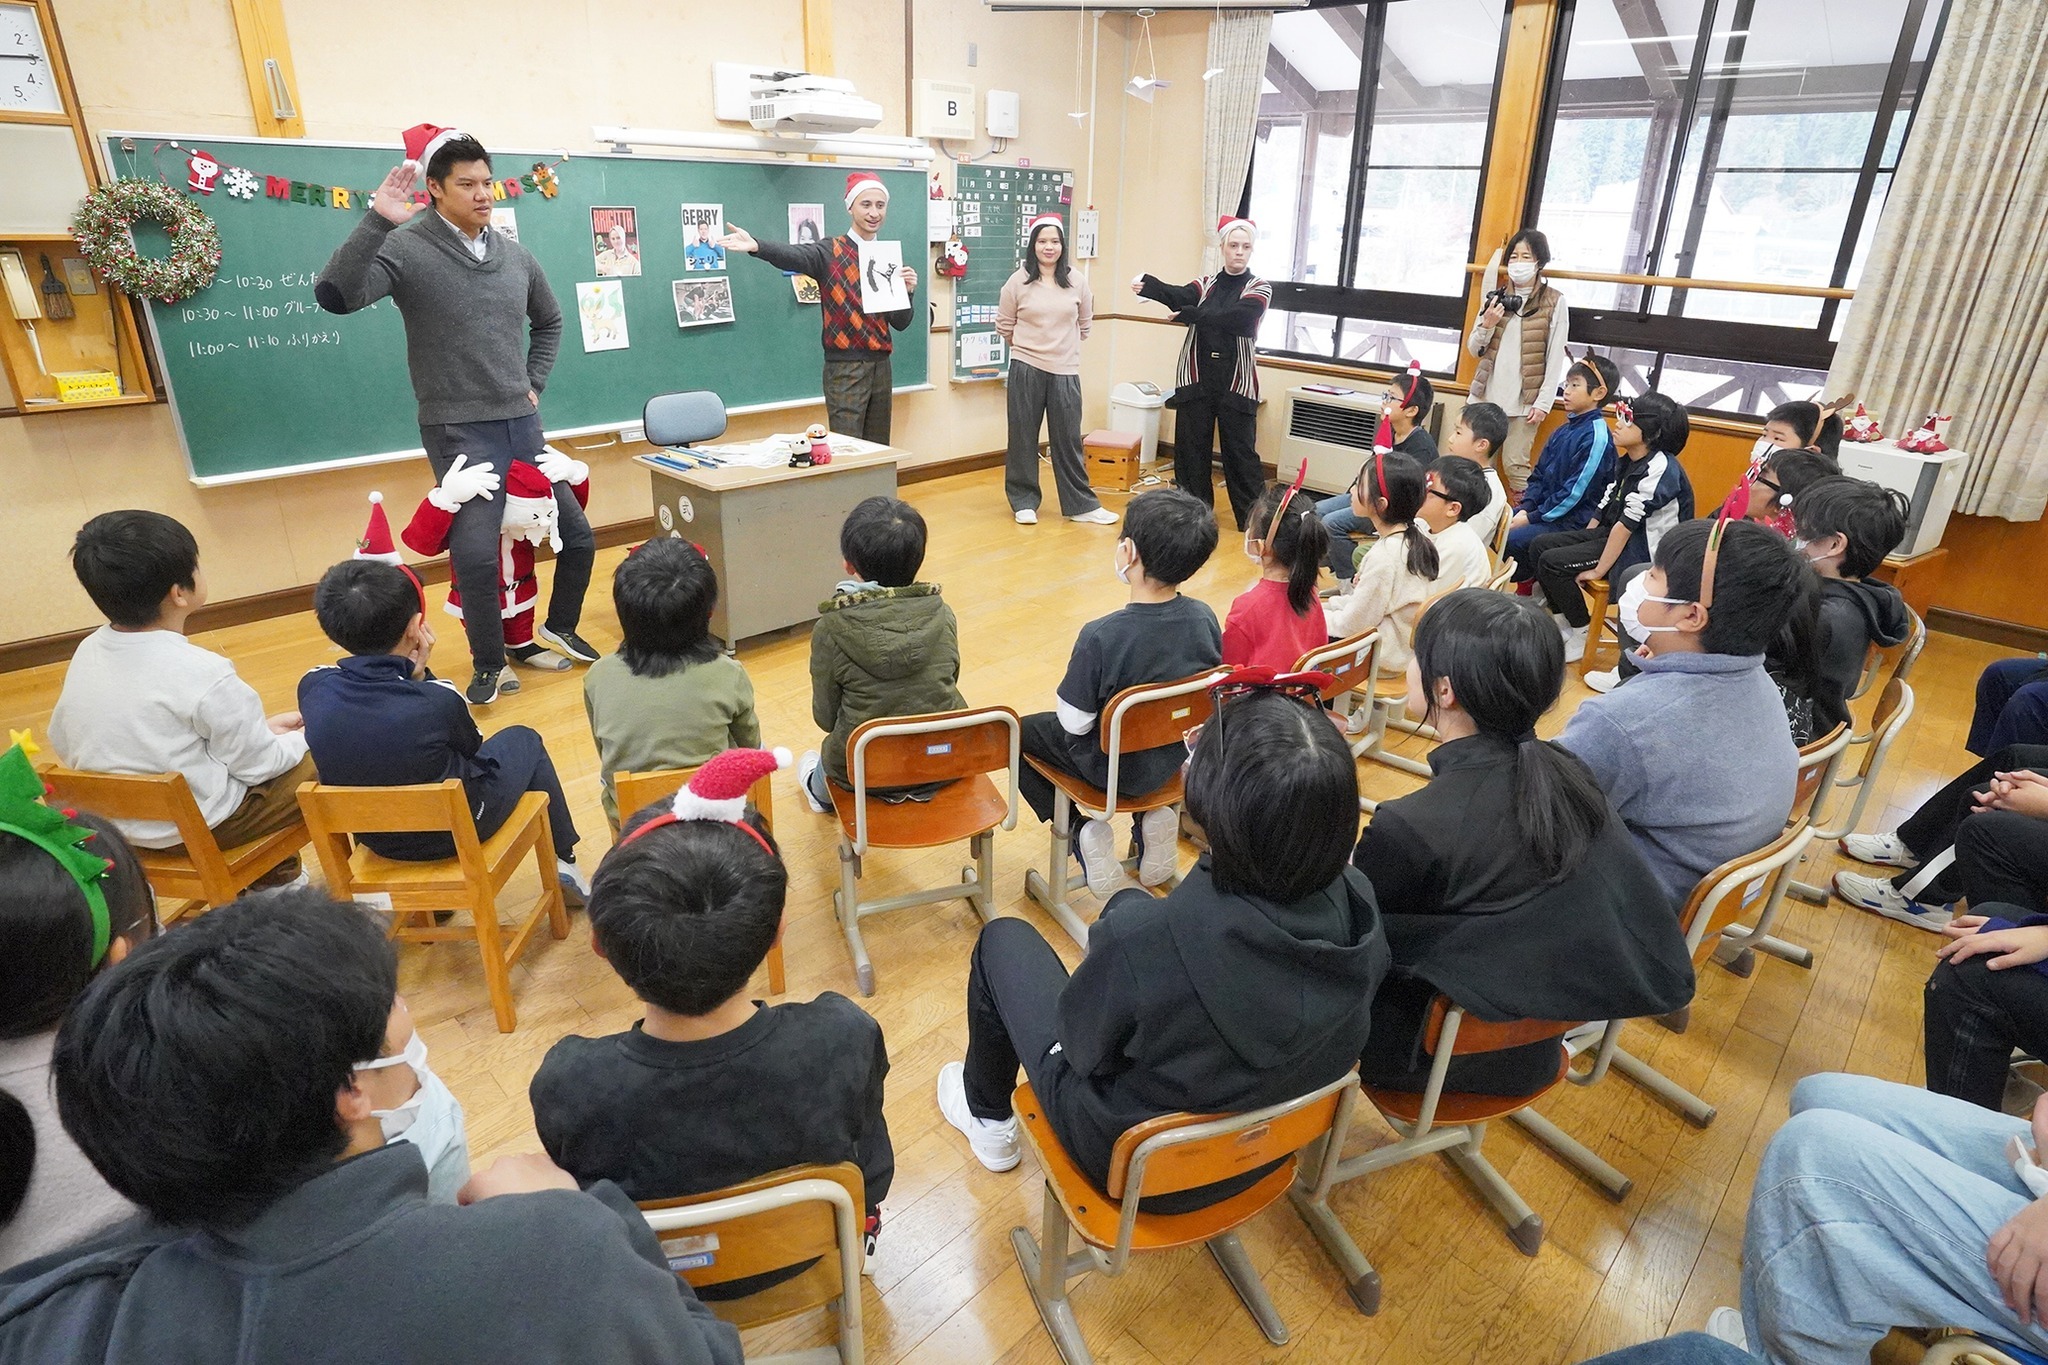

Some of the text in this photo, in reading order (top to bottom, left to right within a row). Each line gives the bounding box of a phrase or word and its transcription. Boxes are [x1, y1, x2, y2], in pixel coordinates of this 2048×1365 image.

[14, 33, 24, 45] 2
[27, 73, 36, 84] 4
[14, 86, 24, 97] 5
[947, 100, 957, 116] B
[265, 175, 371, 210] MERRY
